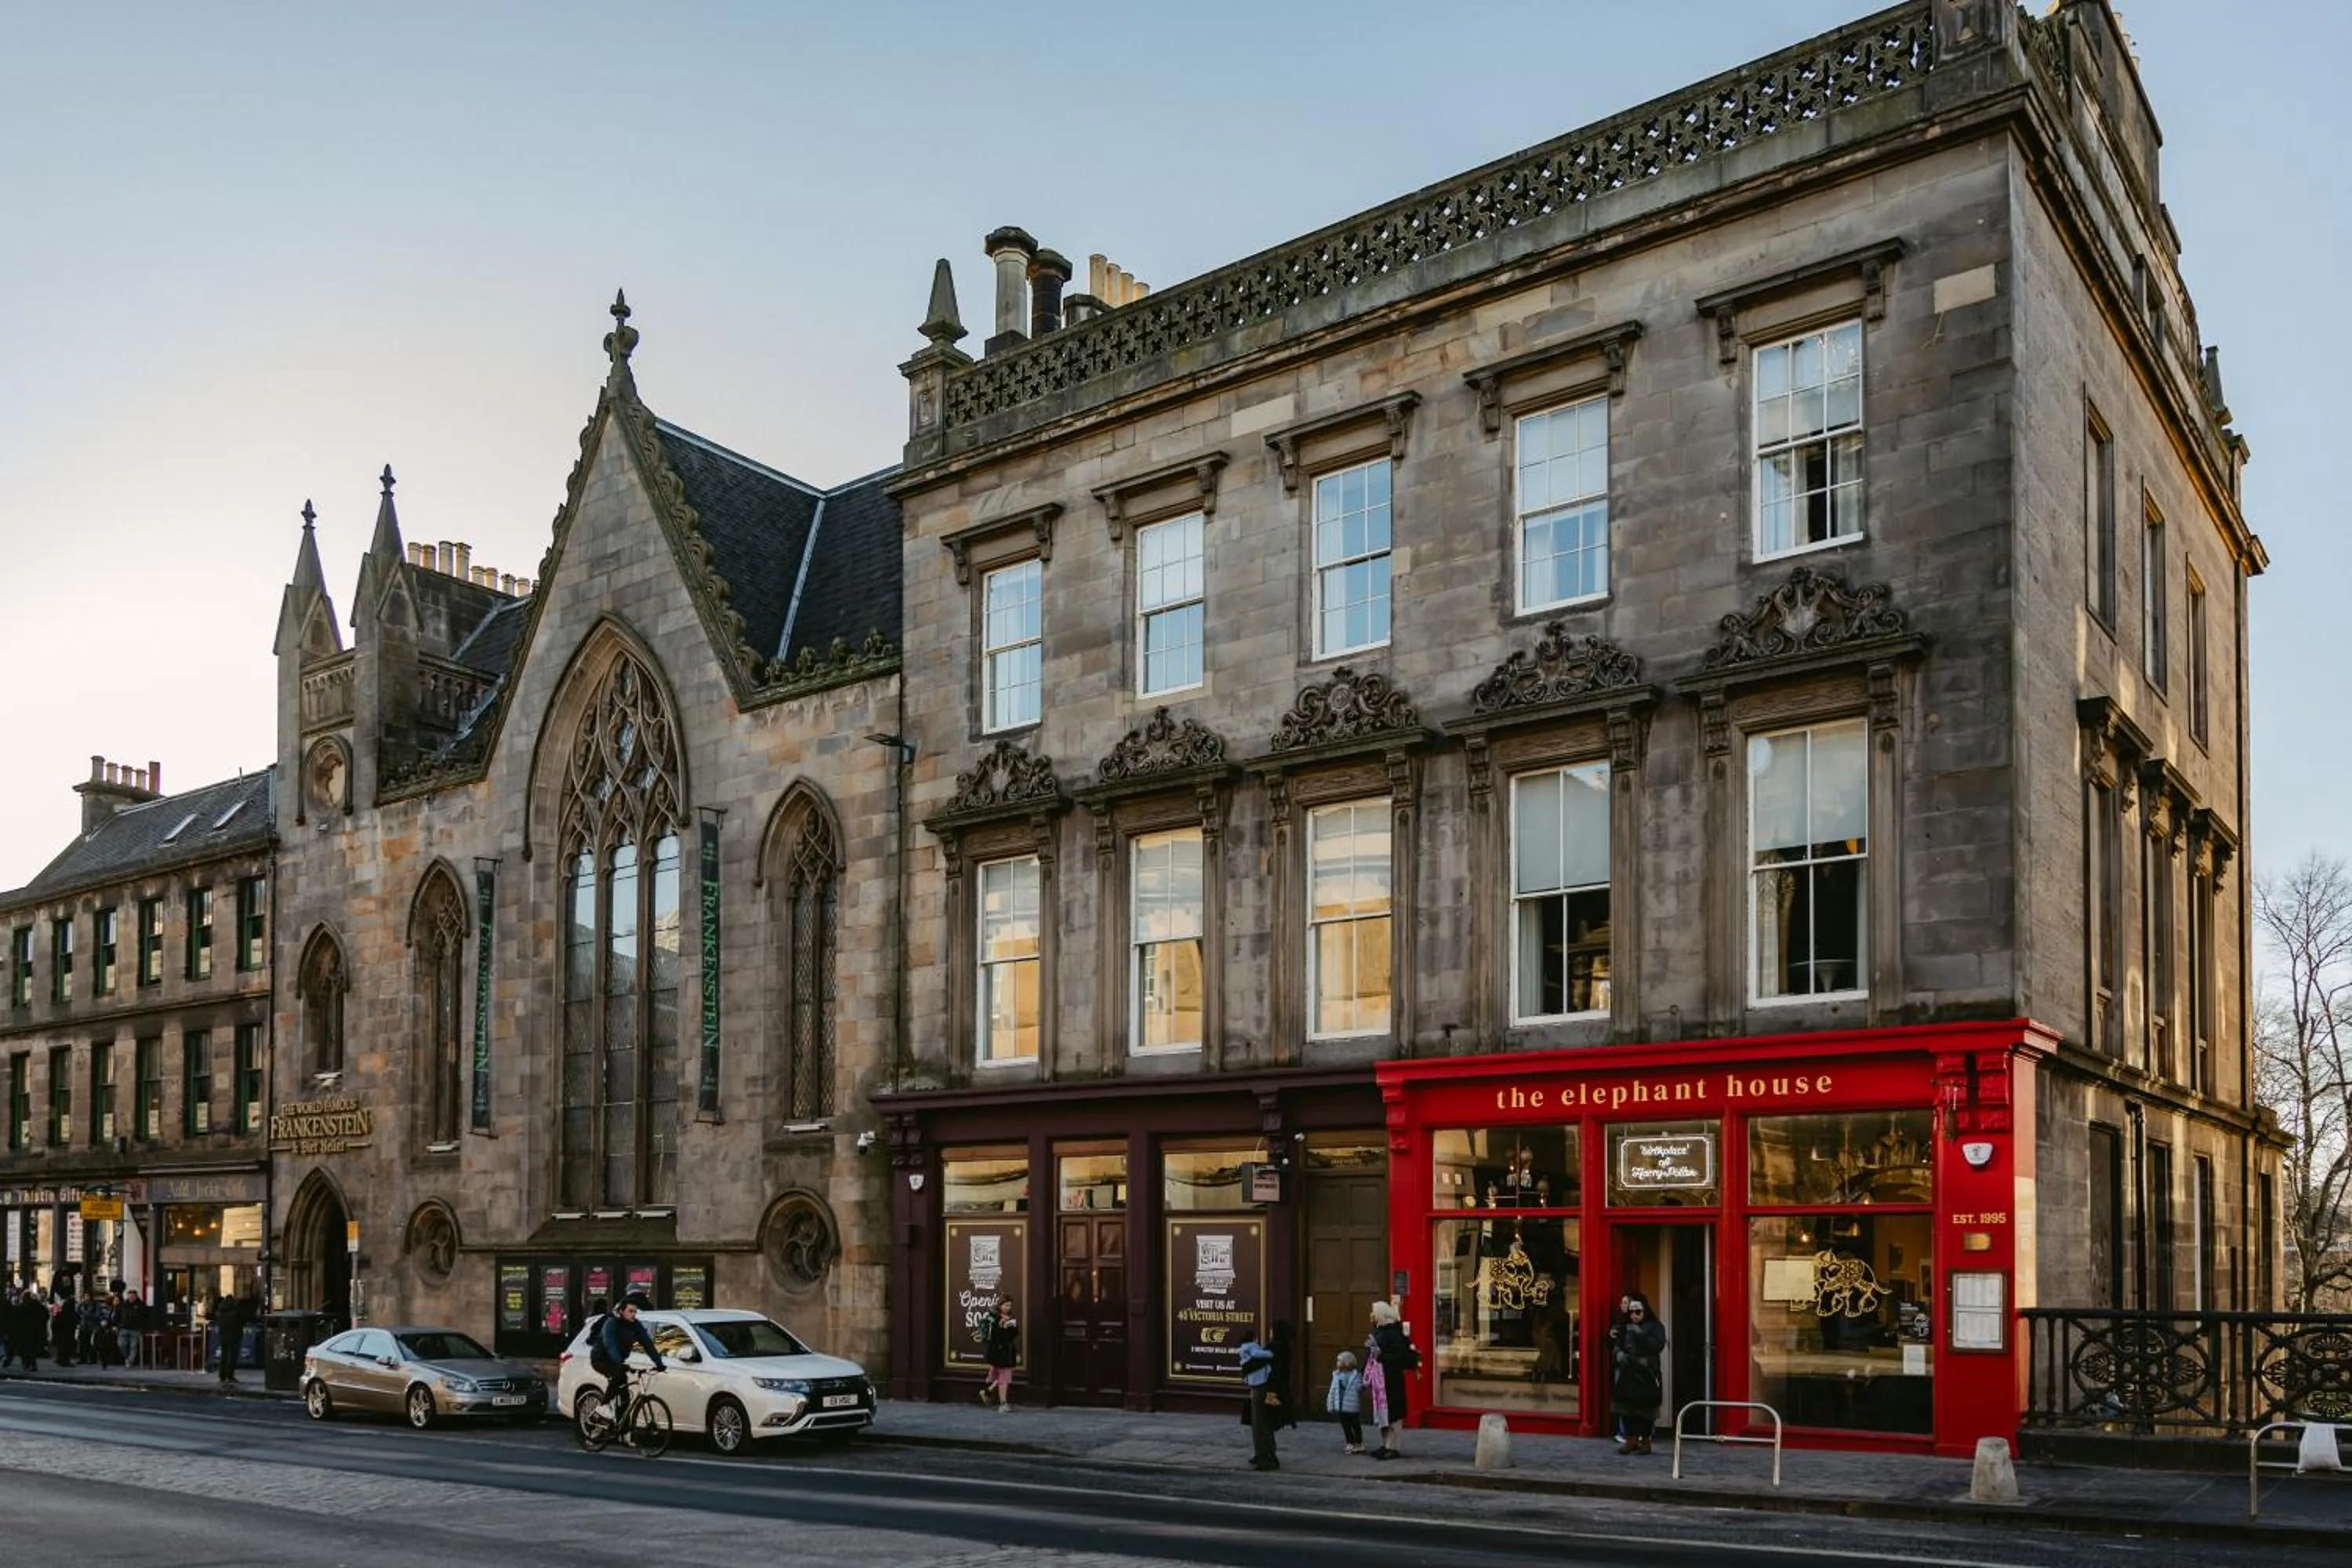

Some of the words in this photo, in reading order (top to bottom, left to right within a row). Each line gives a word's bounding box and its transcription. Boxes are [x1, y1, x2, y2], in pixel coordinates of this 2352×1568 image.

[703, 880, 719, 1047] FRANKENSTEIN
[1496, 1087, 1544, 1109] the
[1561, 1078, 1707, 1109] elephant
[1726, 1075, 1833, 1097] house
[281, 1103, 296, 1116] THE
[296, 1102, 324, 1114] WORLD
[324, 1098, 358, 1112] FAMOUS
[270, 1108, 372, 1139] FRANKENSTEIN
[1952, 1214, 1976, 1225] EST.
[1980, 1213, 2006, 1224] 1995
[1196, 1299, 1214, 1309] VISIT
[1215, 1299, 1225, 1310] US
[1226, 1300, 1236, 1310] AT
[1189, 1310, 1224, 1322] VICTORIA
[1225, 1311, 1254, 1323] STREET
